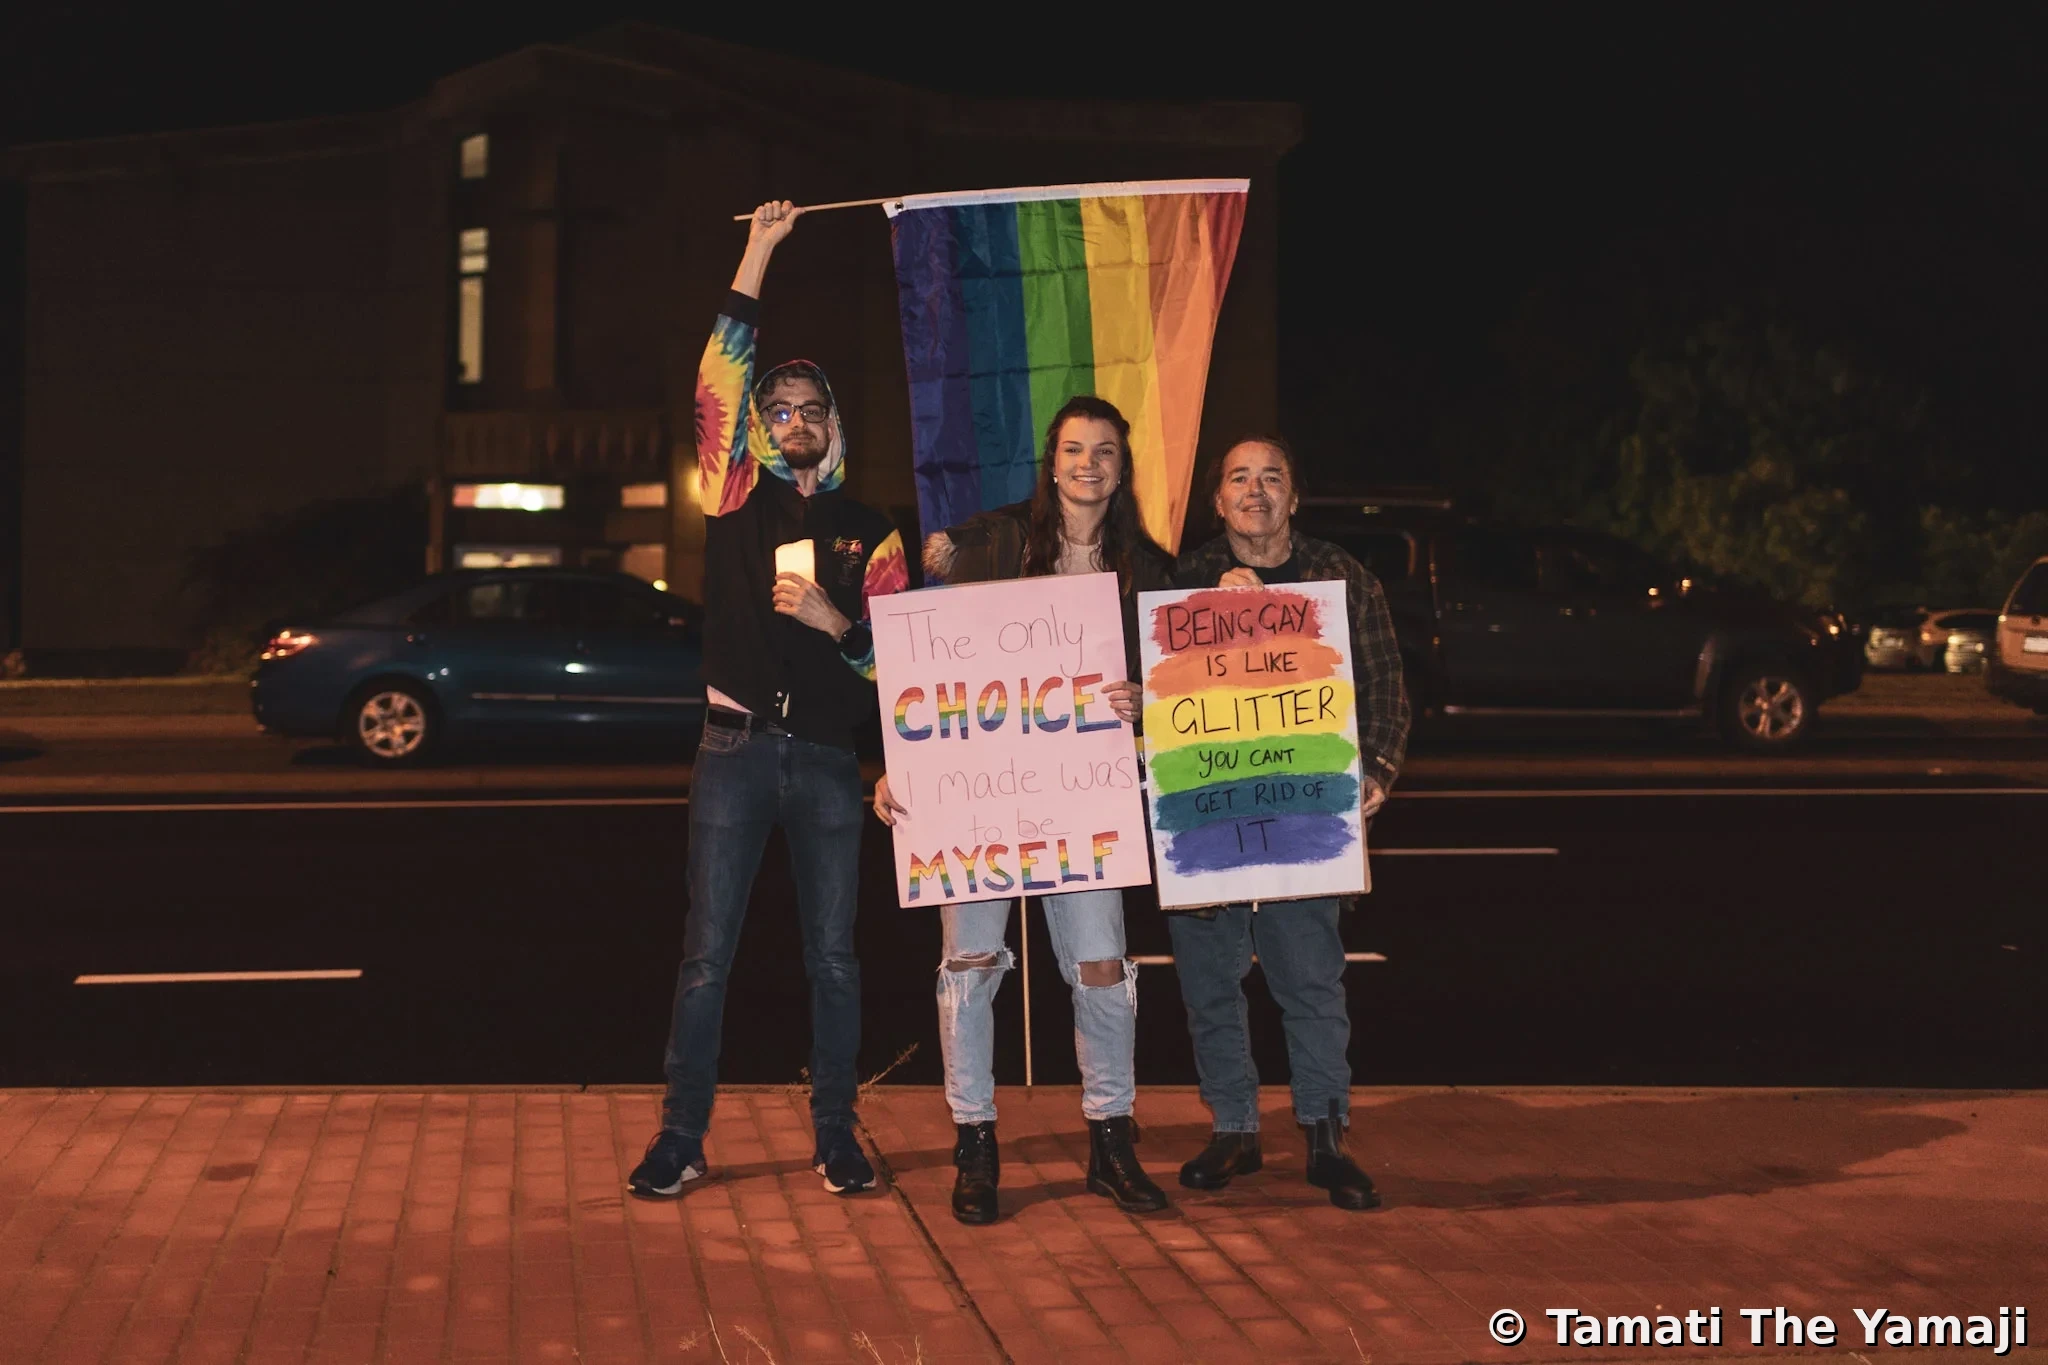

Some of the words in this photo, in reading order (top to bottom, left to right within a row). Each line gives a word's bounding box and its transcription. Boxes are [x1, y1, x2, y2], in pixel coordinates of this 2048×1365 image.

[888, 608, 976, 662] The
[998, 604, 1084, 678] only
[1166, 605, 1253, 651] BEING
[1258, 600, 1309, 634] GAY
[1206, 654, 1227, 677] IS
[1245, 651, 1298, 673] LIKE
[894, 673, 1122, 741] CHOICE
[1171, 685, 1336, 735] GLITTER
[906, 771, 913, 807] I
[938, 757, 1043, 804] made
[1060, 756, 1134, 792] was
[1198, 749, 1239, 779] YOU
[1250, 748, 1295, 767] CANT
[1194, 787, 1238, 814] GET
[1254, 782, 1296, 805] RID
[1302, 780, 1325, 799] OF
[968, 814, 1002, 843] to
[1016, 807, 1071, 838] be
[1235, 818, 1279, 853] IT
[908, 830, 1119, 902] MYSELF
